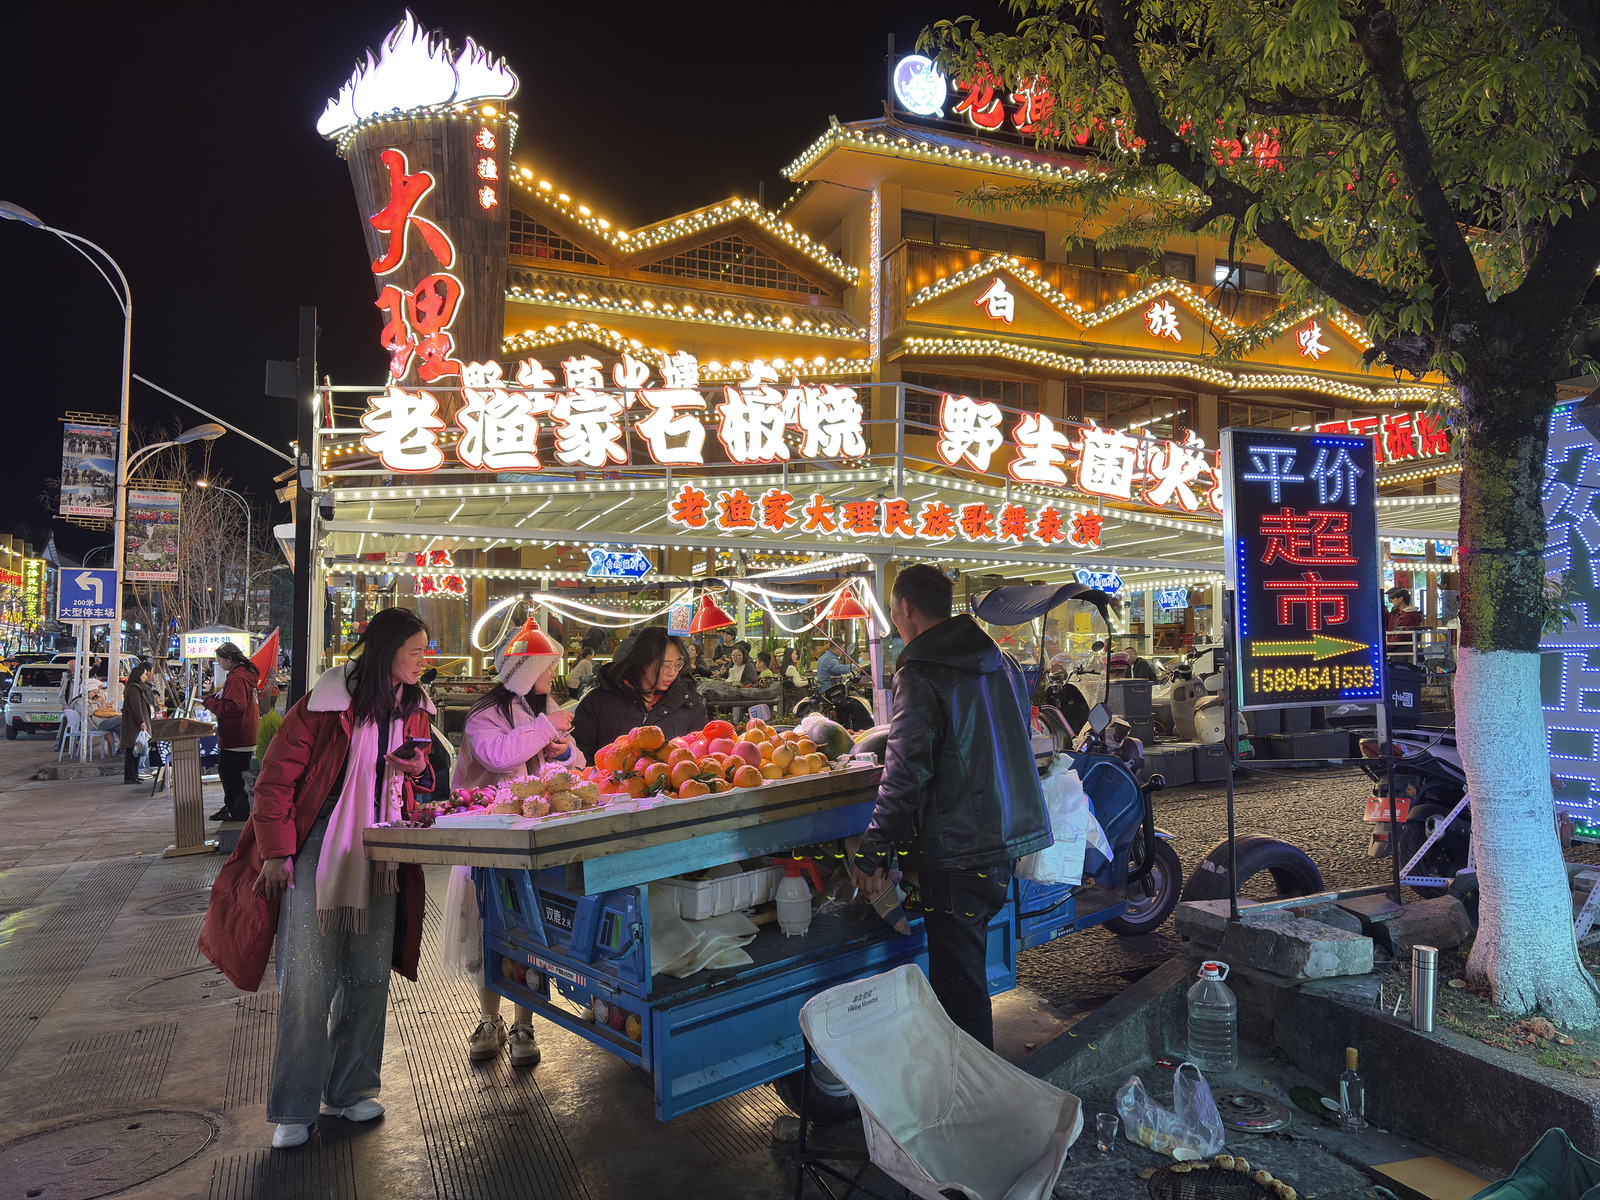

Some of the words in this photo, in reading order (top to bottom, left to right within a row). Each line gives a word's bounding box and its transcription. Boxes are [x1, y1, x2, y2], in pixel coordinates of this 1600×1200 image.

[475, 126, 499, 210] 老渔家
[369, 148, 465, 383] 大理
[360, 383, 870, 474] 老渔家石板烧
[938, 392, 1224, 517] 野生菌火
[1243, 446, 1365, 506] 平价
[666, 484, 1105, 549] 老渔家大理民族歌舞表演
[61, 607, 115, 618] 大型停车场
[73, 599, 94, 607] 200米
[1250, 665, 1375, 693] 15894541559
[847, 1003, 862, 1013] Hiking
[861, 996, 879, 1008] Monster
